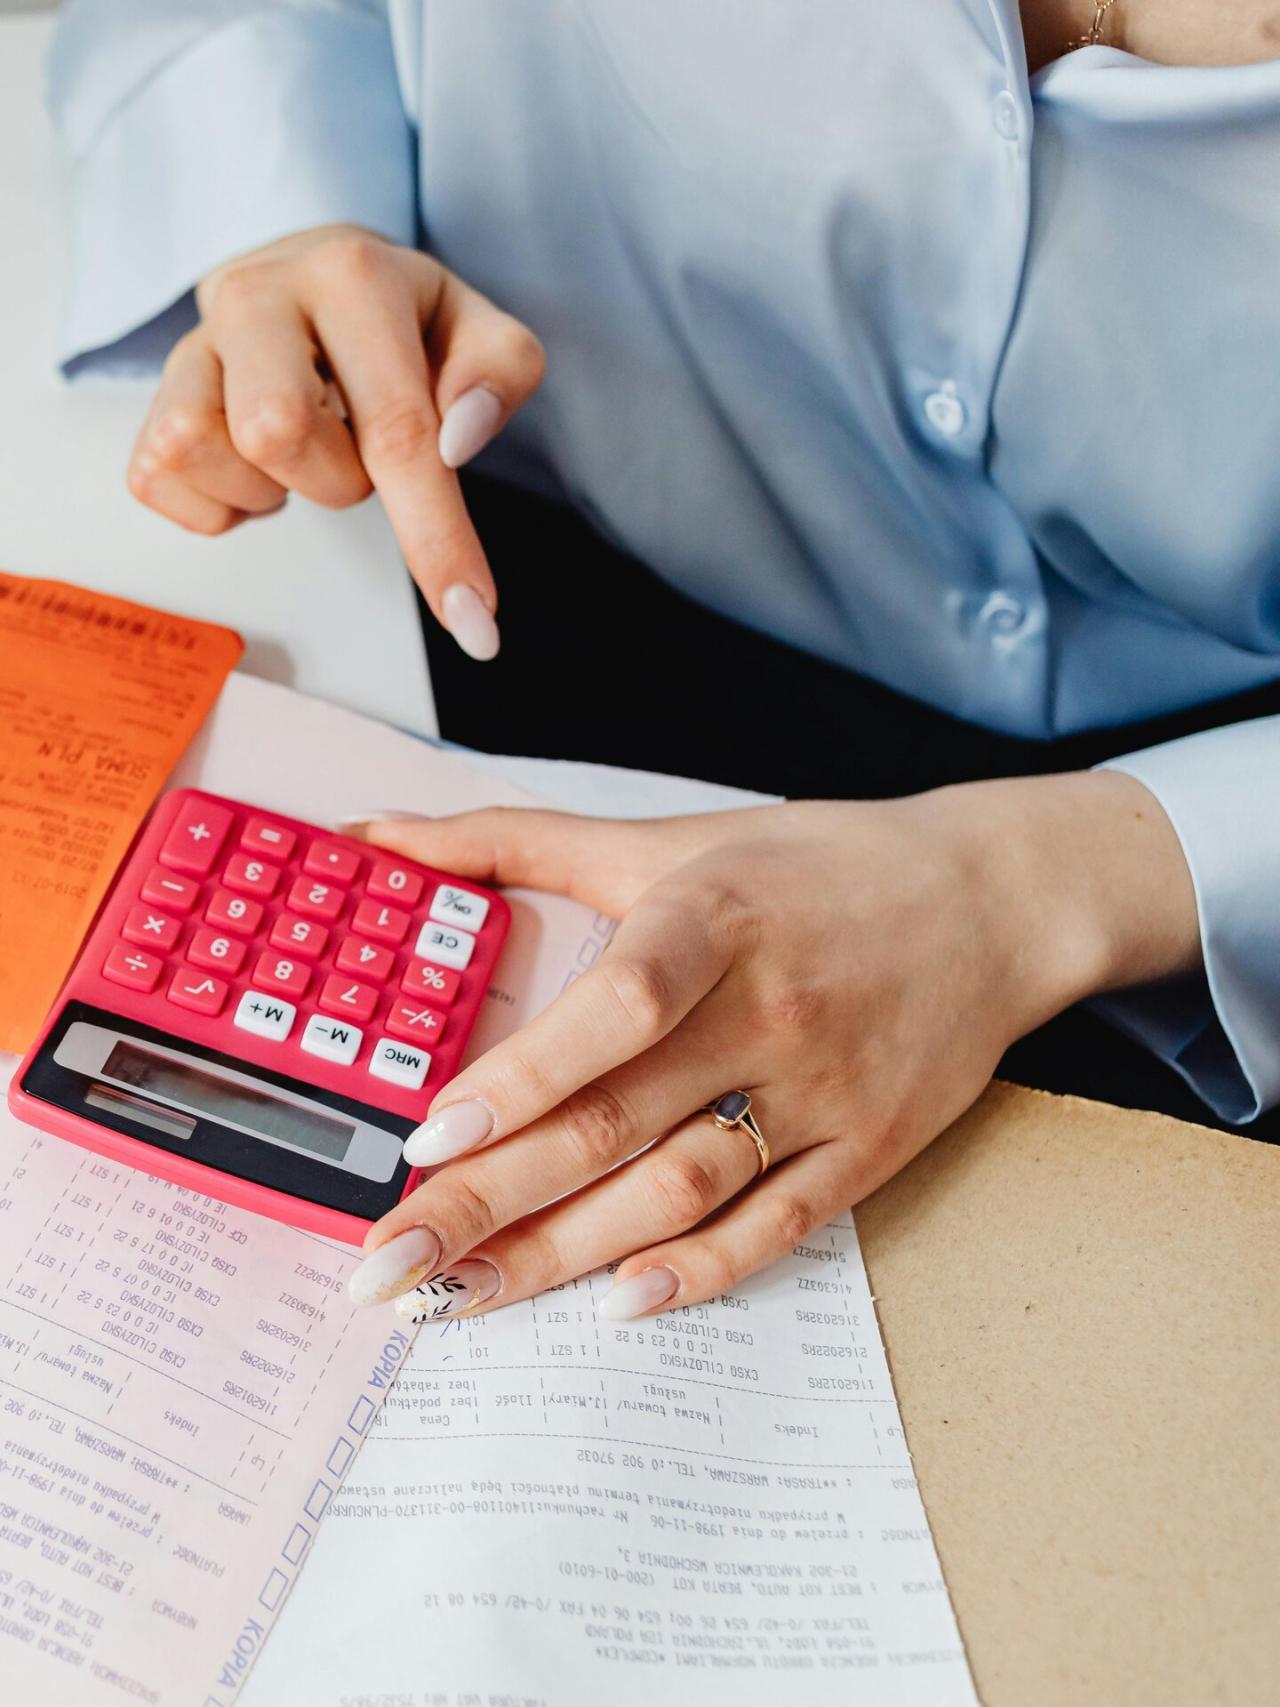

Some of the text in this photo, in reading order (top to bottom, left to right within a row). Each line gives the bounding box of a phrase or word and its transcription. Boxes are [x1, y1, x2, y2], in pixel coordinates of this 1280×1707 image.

[244, 863, 264, 880] 3
[388, 871, 406, 890] 0
[308, 884, 329, 903] 2
[227, 900, 246, 917] 6
[376, 908, 389, 927] 1
[291, 922, 311, 940] 5
[432, 931, 459, 950] CE
[210, 938, 229, 956] 9
[360, 945, 377, 963] 4
[274, 961, 294, 978] 8
[340, 985, 357, 1003] 7
[250, 1003, 284, 1022] M+
[384, 1047, 420, 1069] MRC
[367, 1329, 410, 1390] KOPIA
[217, 1617, 266, 1689] KOPIA
